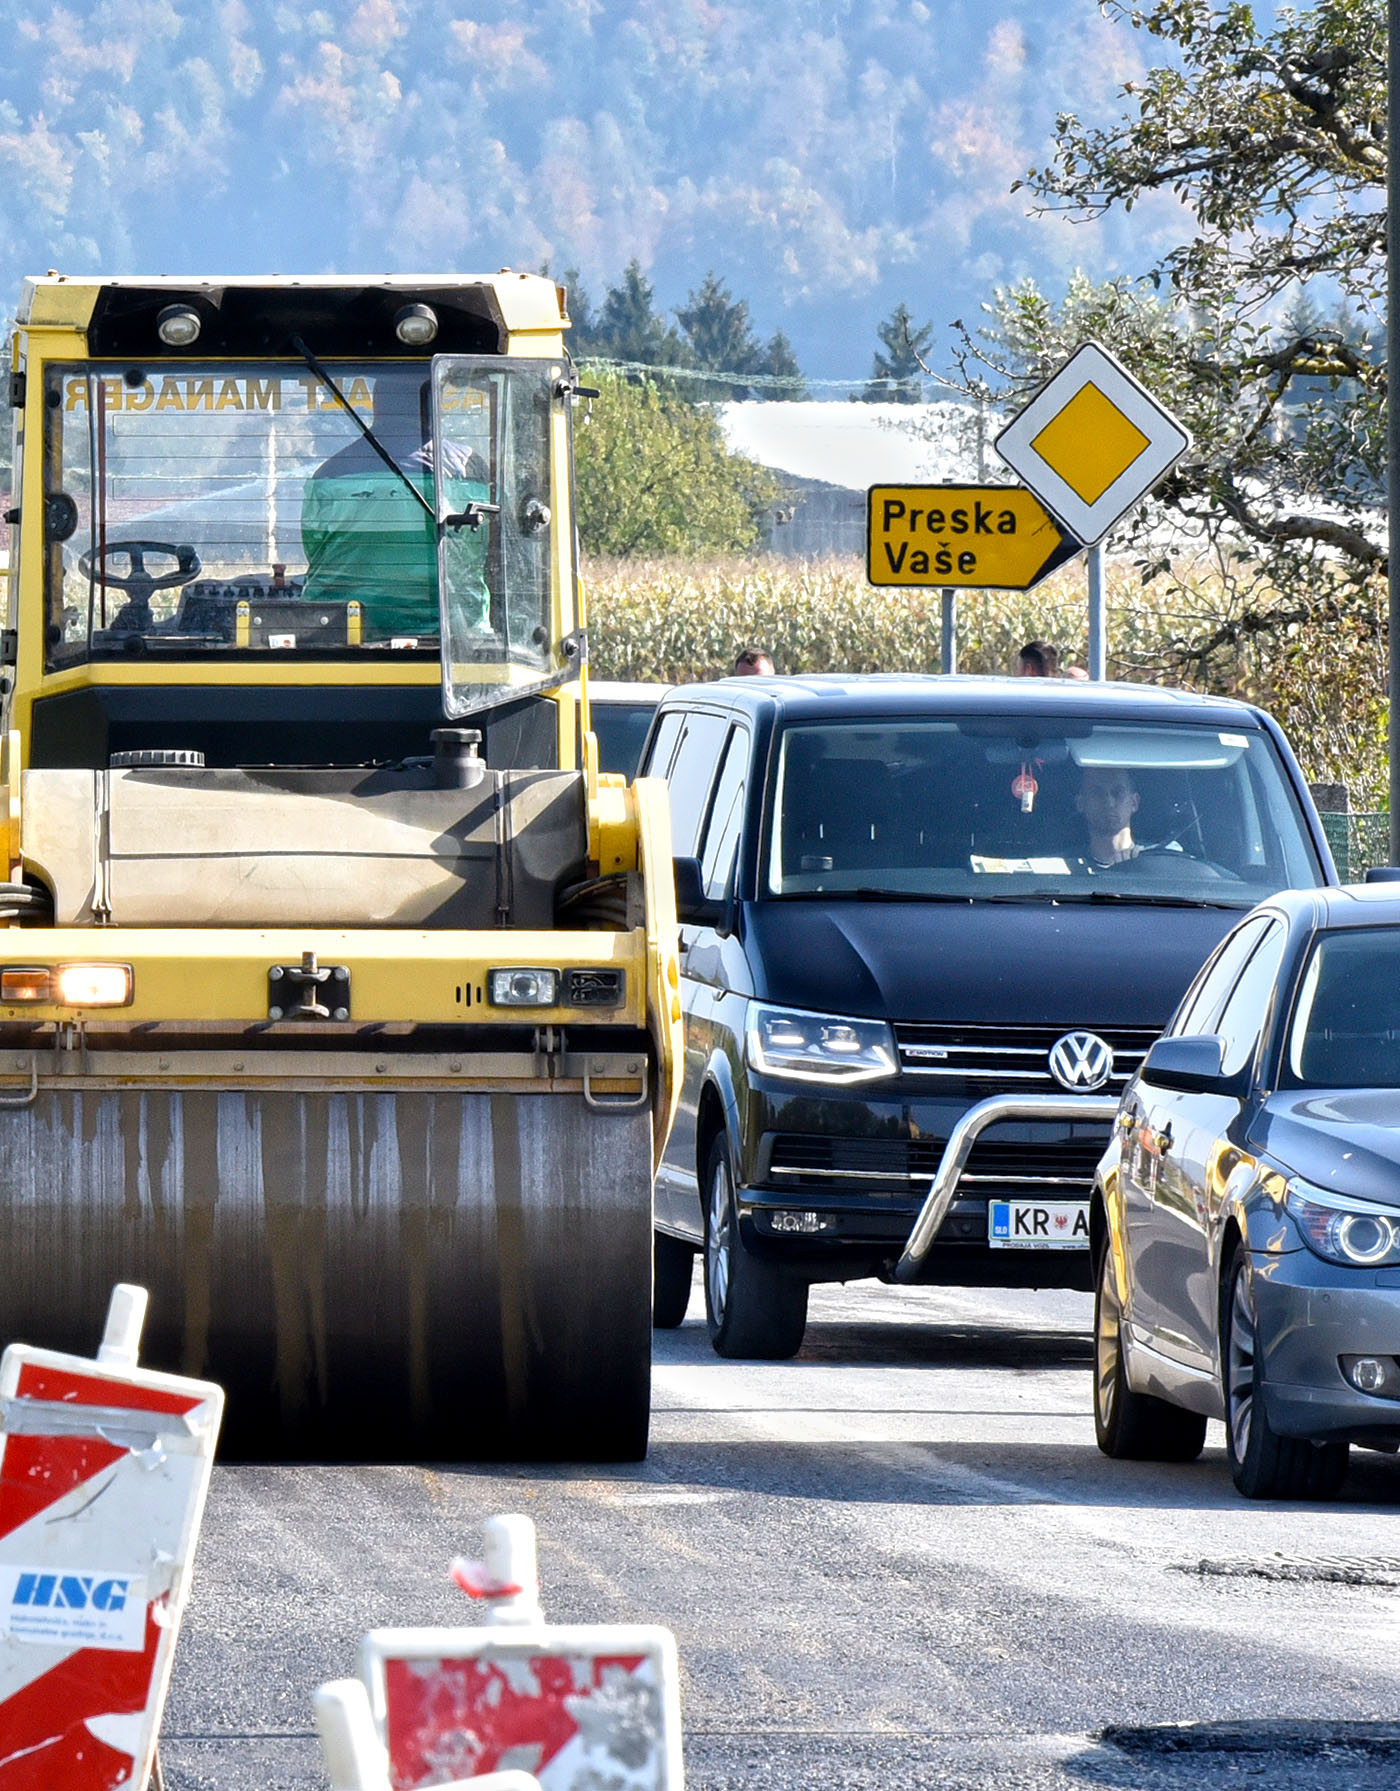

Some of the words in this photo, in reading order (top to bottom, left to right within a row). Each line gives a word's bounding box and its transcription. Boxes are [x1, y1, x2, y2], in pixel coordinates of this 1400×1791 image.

[883, 499, 1017, 534] Preska
[883, 541, 977, 575] Vaše
[1014, 1208, 1050, 1236] KR
[12, 1573, 129, 1611] HNG
